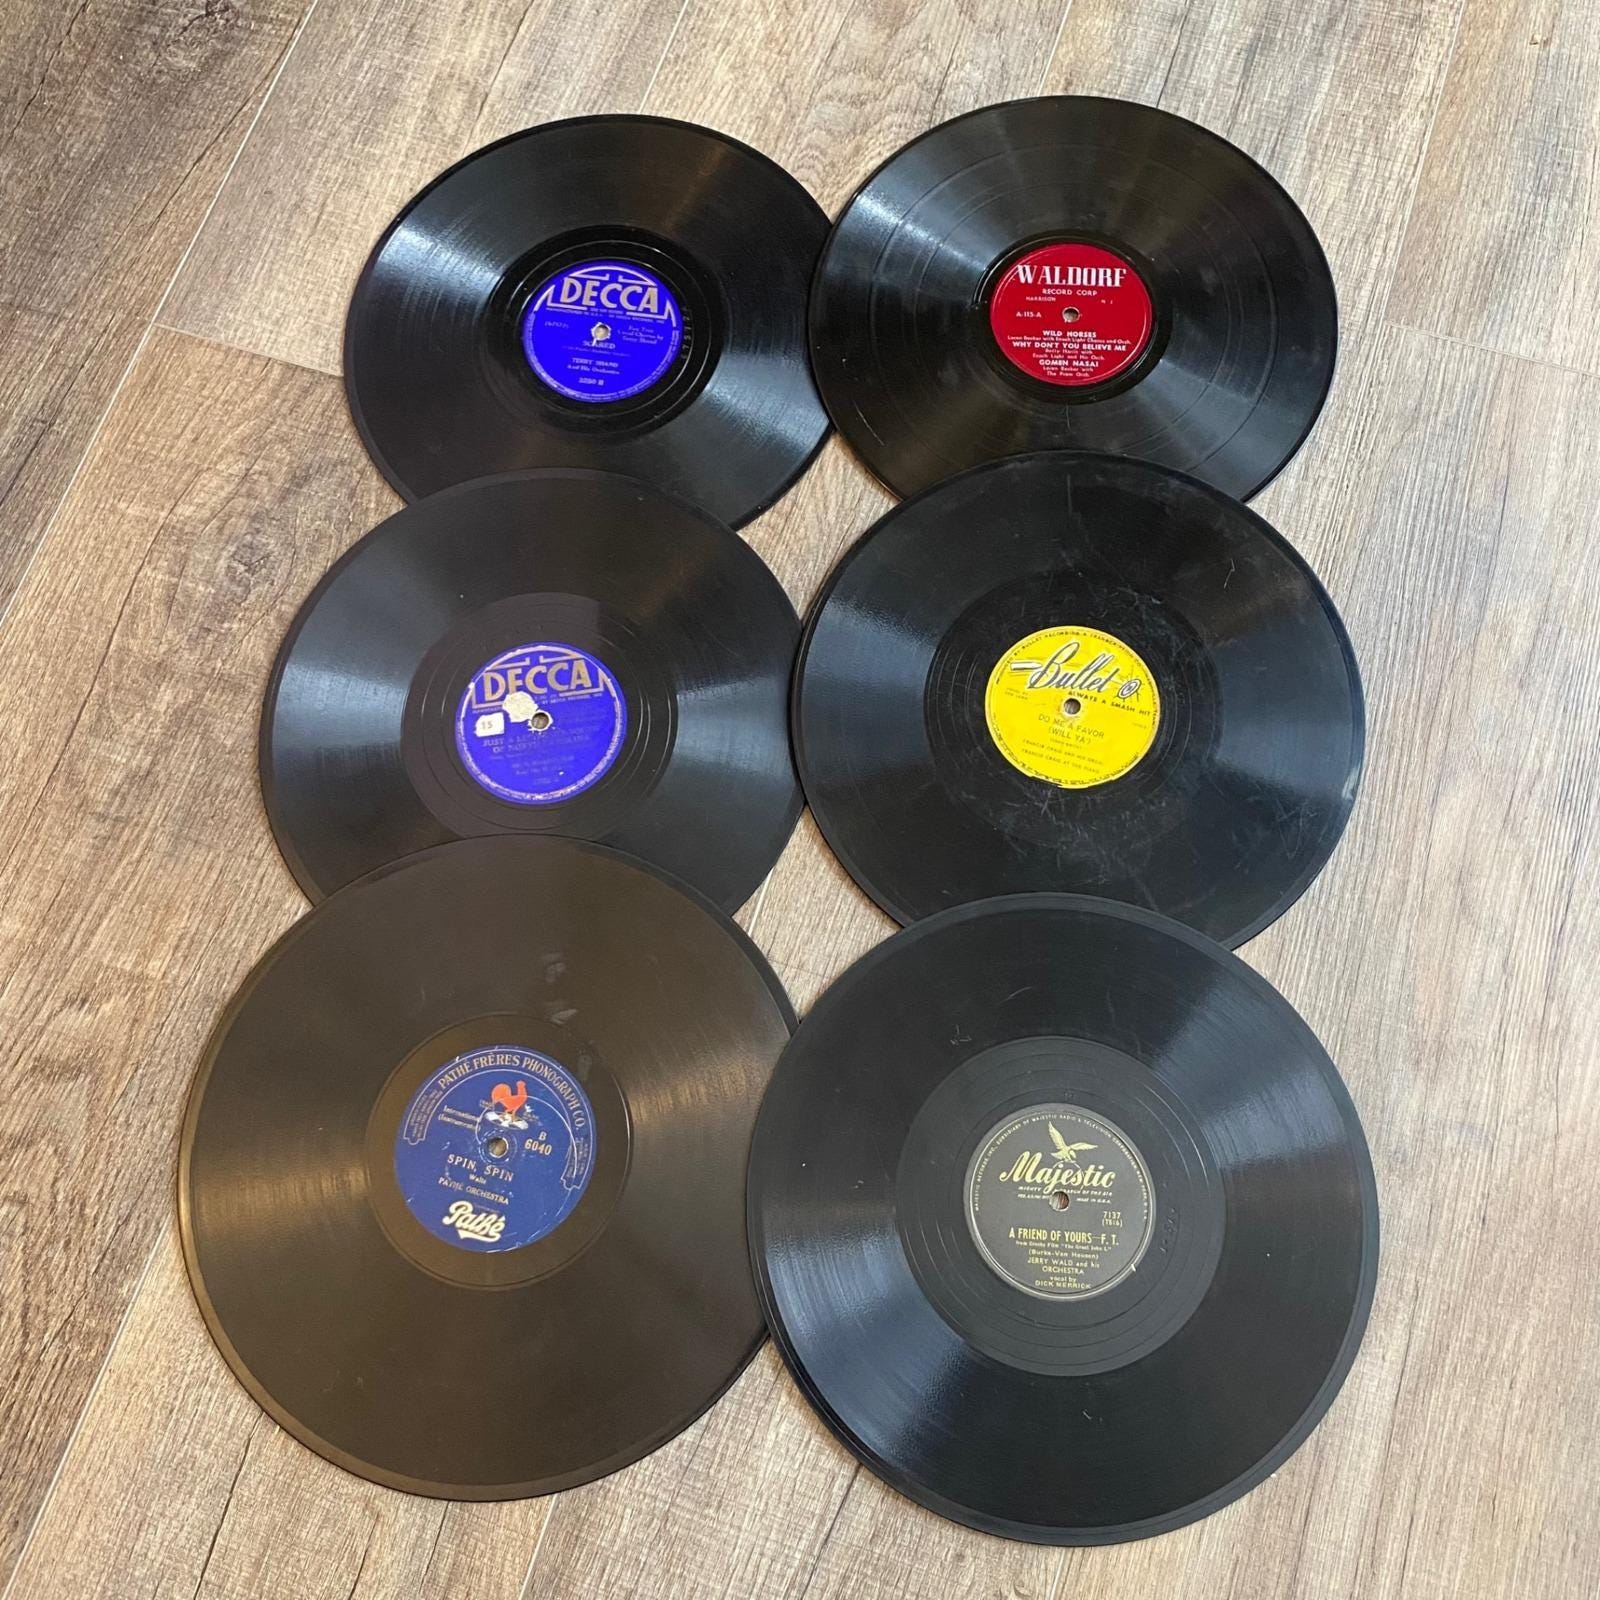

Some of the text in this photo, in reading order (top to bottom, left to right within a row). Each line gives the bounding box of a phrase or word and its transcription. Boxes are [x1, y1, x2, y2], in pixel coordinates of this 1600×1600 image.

[1014, 264, 1127, 288] WALDORF
[559, 276, 659, 314] DECCA
[1042, 288, 1098, 297] RECORD CORP
[1016, 311, 1042, 319] A-115-A
[1042, 330, 1097, 339] WILD HORSES
[1034, 341, 1060, 349] DON'T
[1062, 342, 1080, 350] YOU
[1039, 359, 1099, 368] GOMEN NASAI
[1027, 641, 1120, 693] Bullet
[482, 659, 592, 702] DECCA
[1068, 690, 1098, 703] ALWAYS
[1111, 701, 1136, 713] SMASH
[1139, 709, 1152, 717] HIT
[481, 720, 493, 730] 15
[1038, 713, 1051, 723] DO
[1068, 722, 1074, 730] A
[1076, 724, 1105, 739] FAVOR
[522, 1056, 581, 1111] PHONOGRAPH
[572, 1109, 586, 1132] CO.
[1060, 1113, 1077, 1121] RADIO
[538, 1131, 547, 1141] B
[524, 1138, 553, 1156] 6040
[447, 1153, 514, 1182] SPIN, SPIN
[1000, 1150, 1117, 1194] Majestic
[465, 1185, 510, 1206] ORCHESTRA
[442, 1200, 507, 1242] Pathé
[1103, 1211, 1121, 1219] 7137
[1008, 1227, 1016, 1239] A
[1017, 1227, 1048, 1241] FRIEND
[1050, 1229, 1062, 1241] OF
[1027, 1257, 1100, 1269] JERRY WALD and his
[1041, 1265, 1085, 1275] ORCHESTRA
[1034, 1280, 1092, 1289] DICK MERRICK
[1068, 1276, 1077, 1284] by
